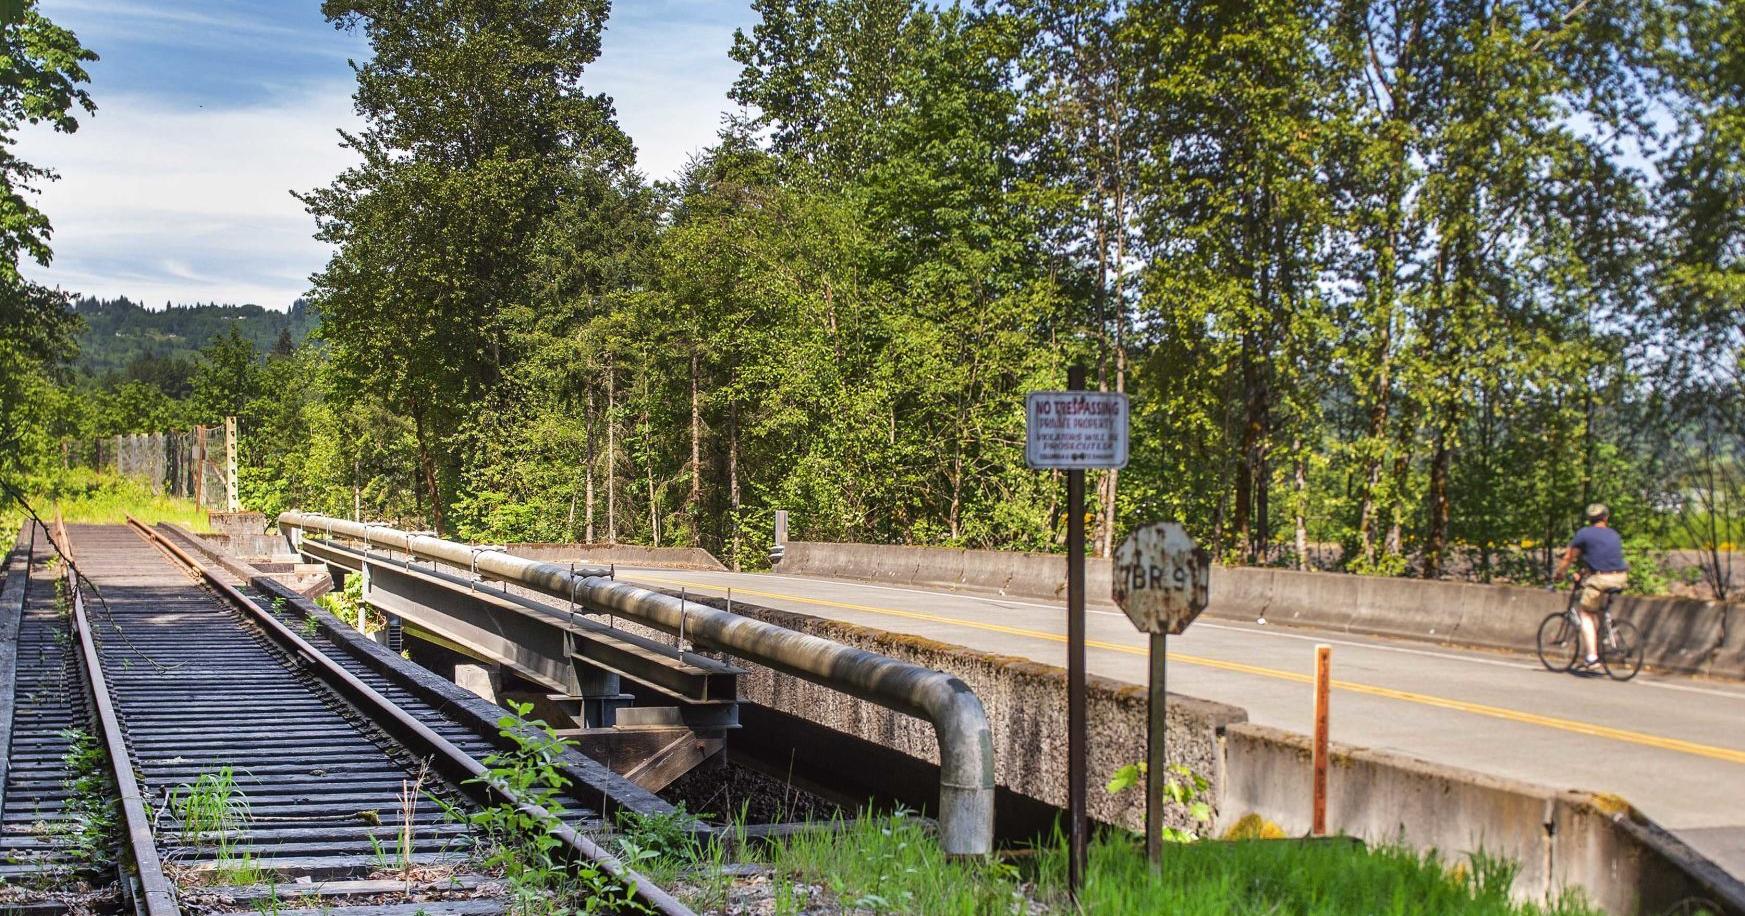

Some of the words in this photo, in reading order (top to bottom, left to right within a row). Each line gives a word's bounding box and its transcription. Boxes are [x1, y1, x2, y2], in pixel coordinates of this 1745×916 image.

[1036, 401, 1051, 415] NO
[1054, 401, 1119, 415] TRESPASSING
[1039, 417, 1070, 429] PRIVATE
[1073, 417, 1114, 429] PROPERTY
